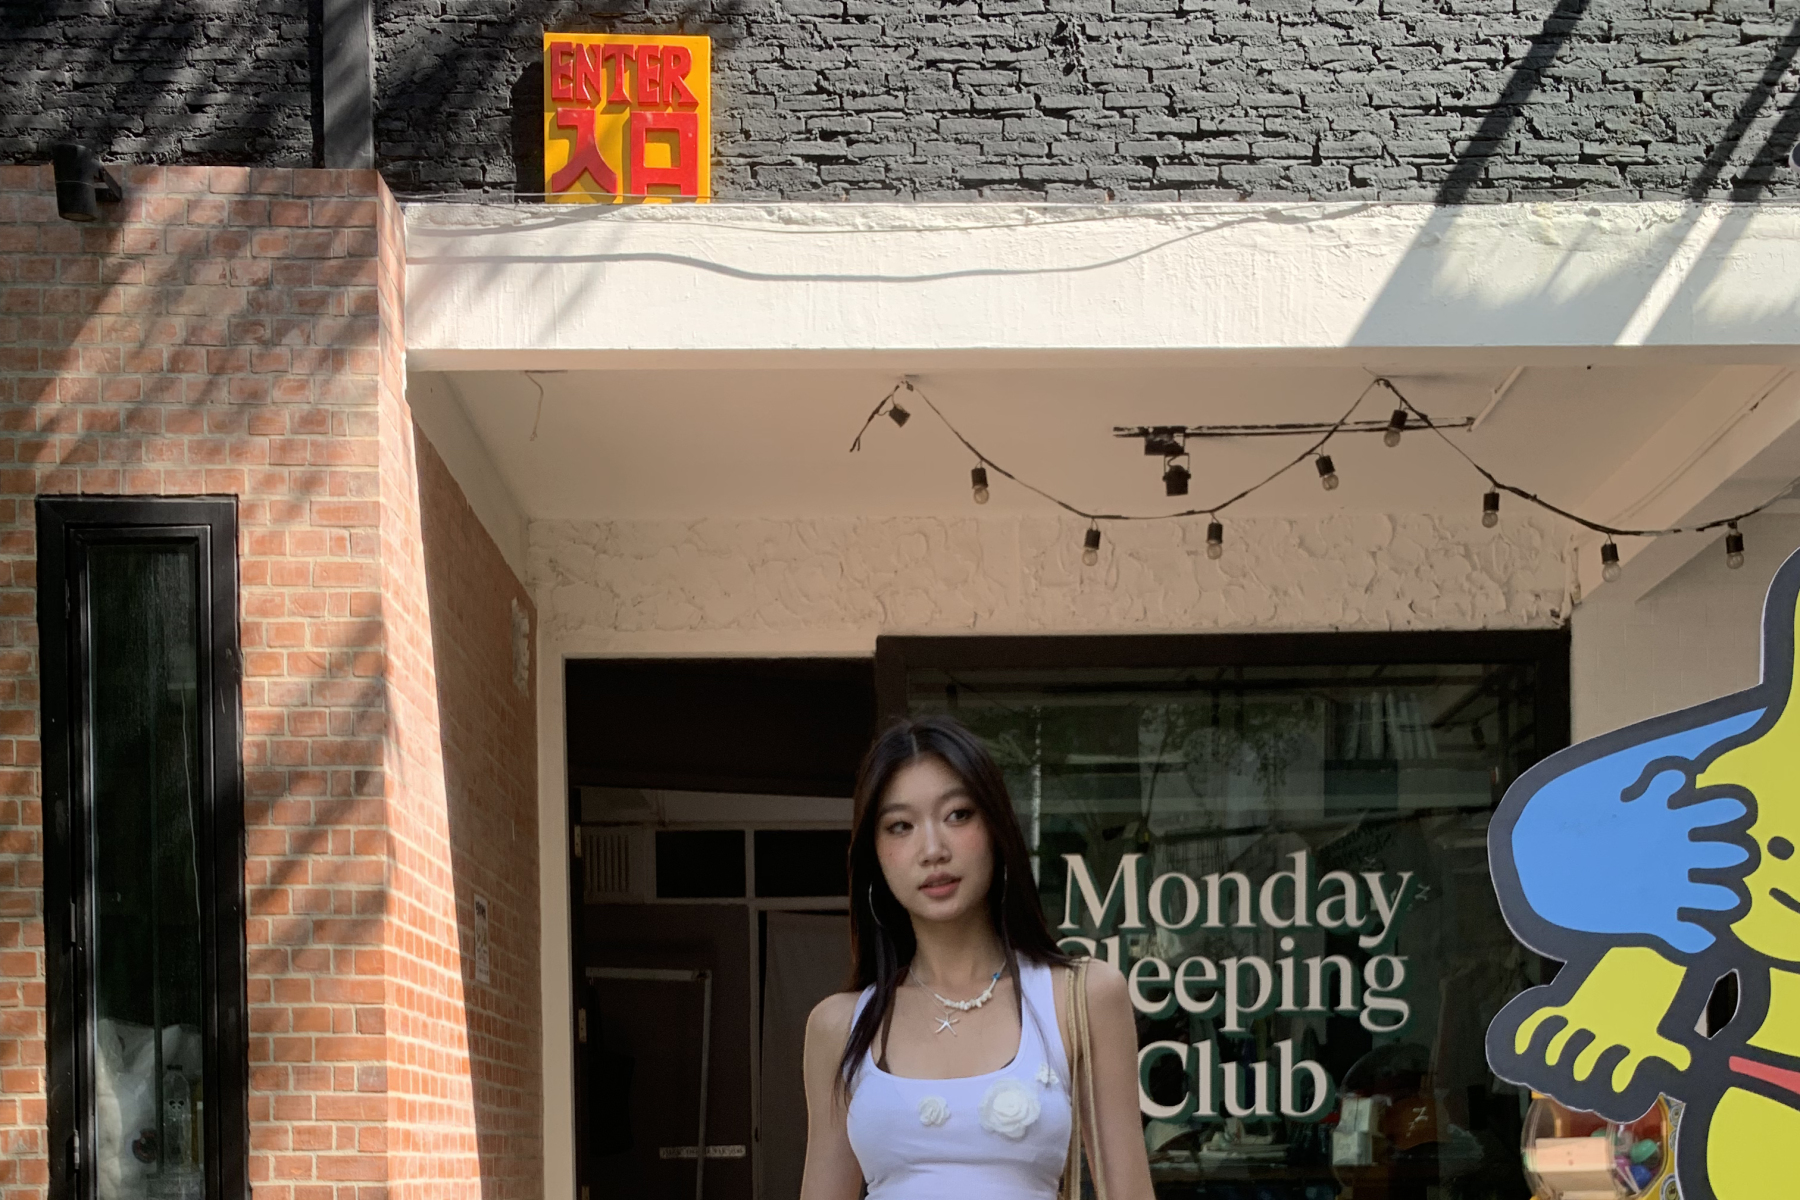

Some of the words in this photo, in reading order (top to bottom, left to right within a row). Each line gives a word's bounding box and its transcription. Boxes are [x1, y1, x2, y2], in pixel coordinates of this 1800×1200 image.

[550, 41, 699, 106] ENTER
[552, 107, 699, 197] 入口
[1057, 850, 1414, 948] Monday
[1138, 1038, 1328, 1119] Club
